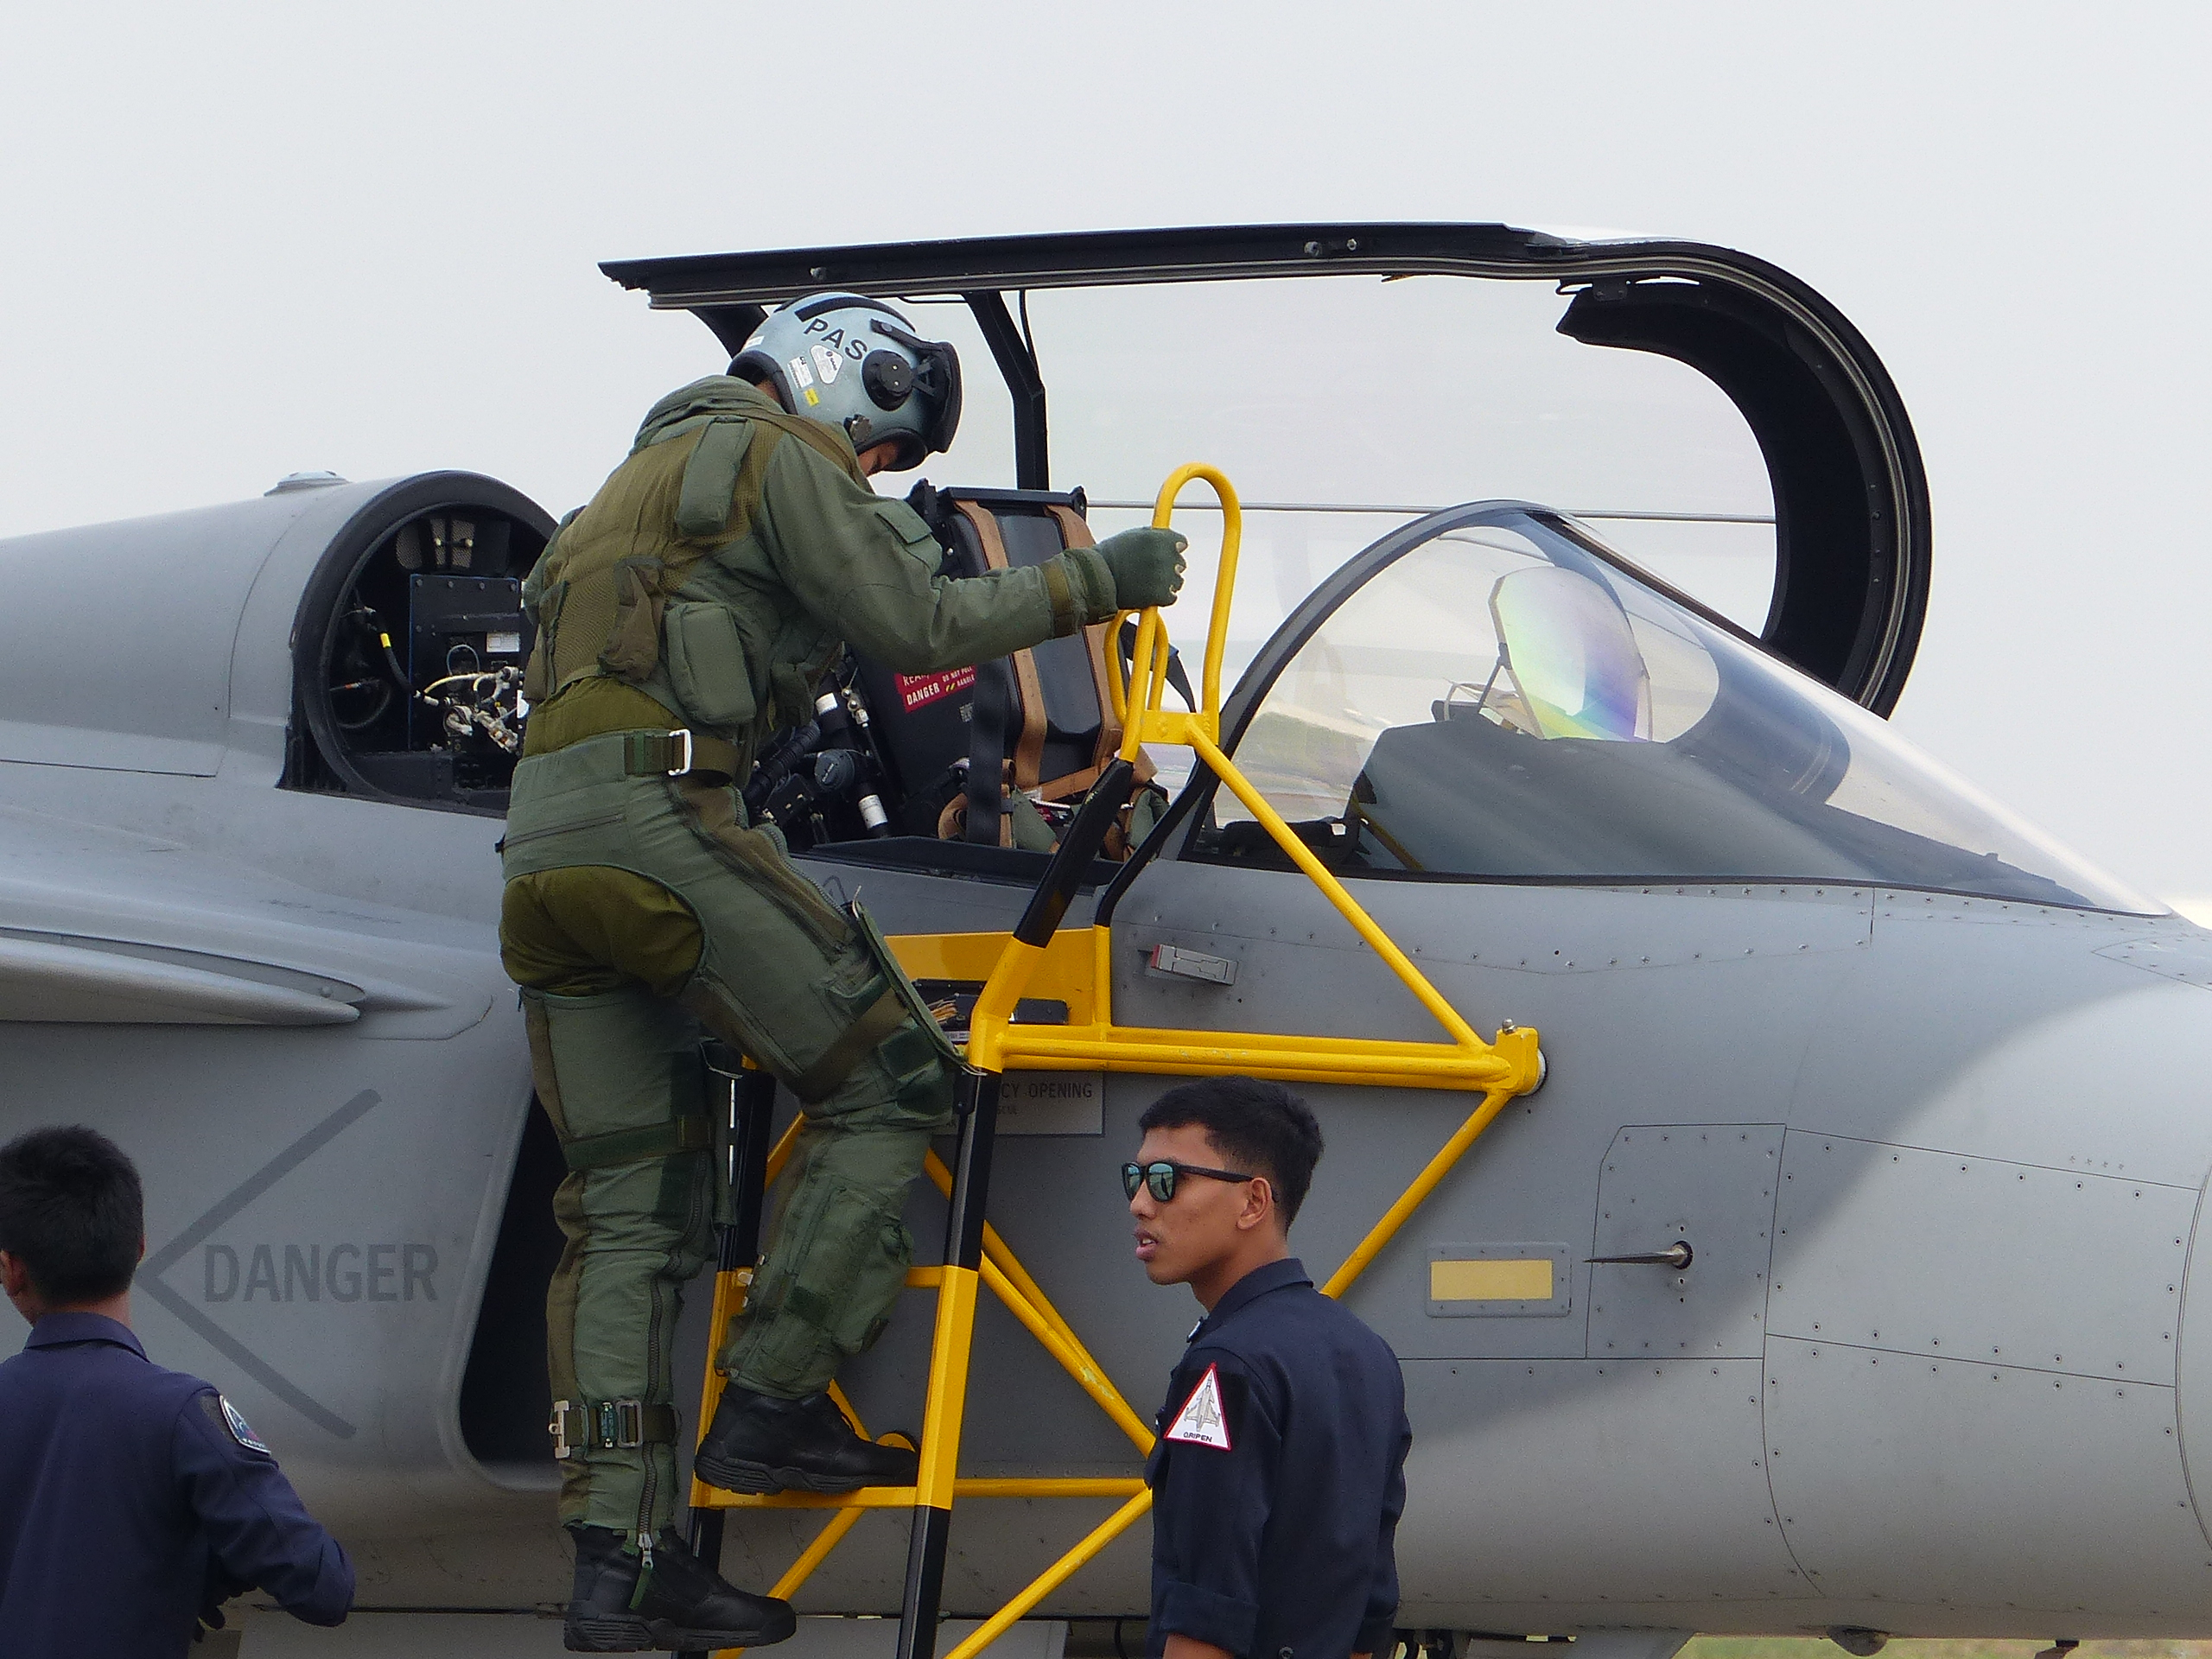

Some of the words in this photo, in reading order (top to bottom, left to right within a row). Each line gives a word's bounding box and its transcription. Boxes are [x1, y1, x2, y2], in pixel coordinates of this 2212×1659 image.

[803, 318, 868, 360] PAS
[906, 682, 940, 706] DANGER
[1028, 1083, 1093, 1098] OPENING
[204, 1243, 439, 1302] DANGER
